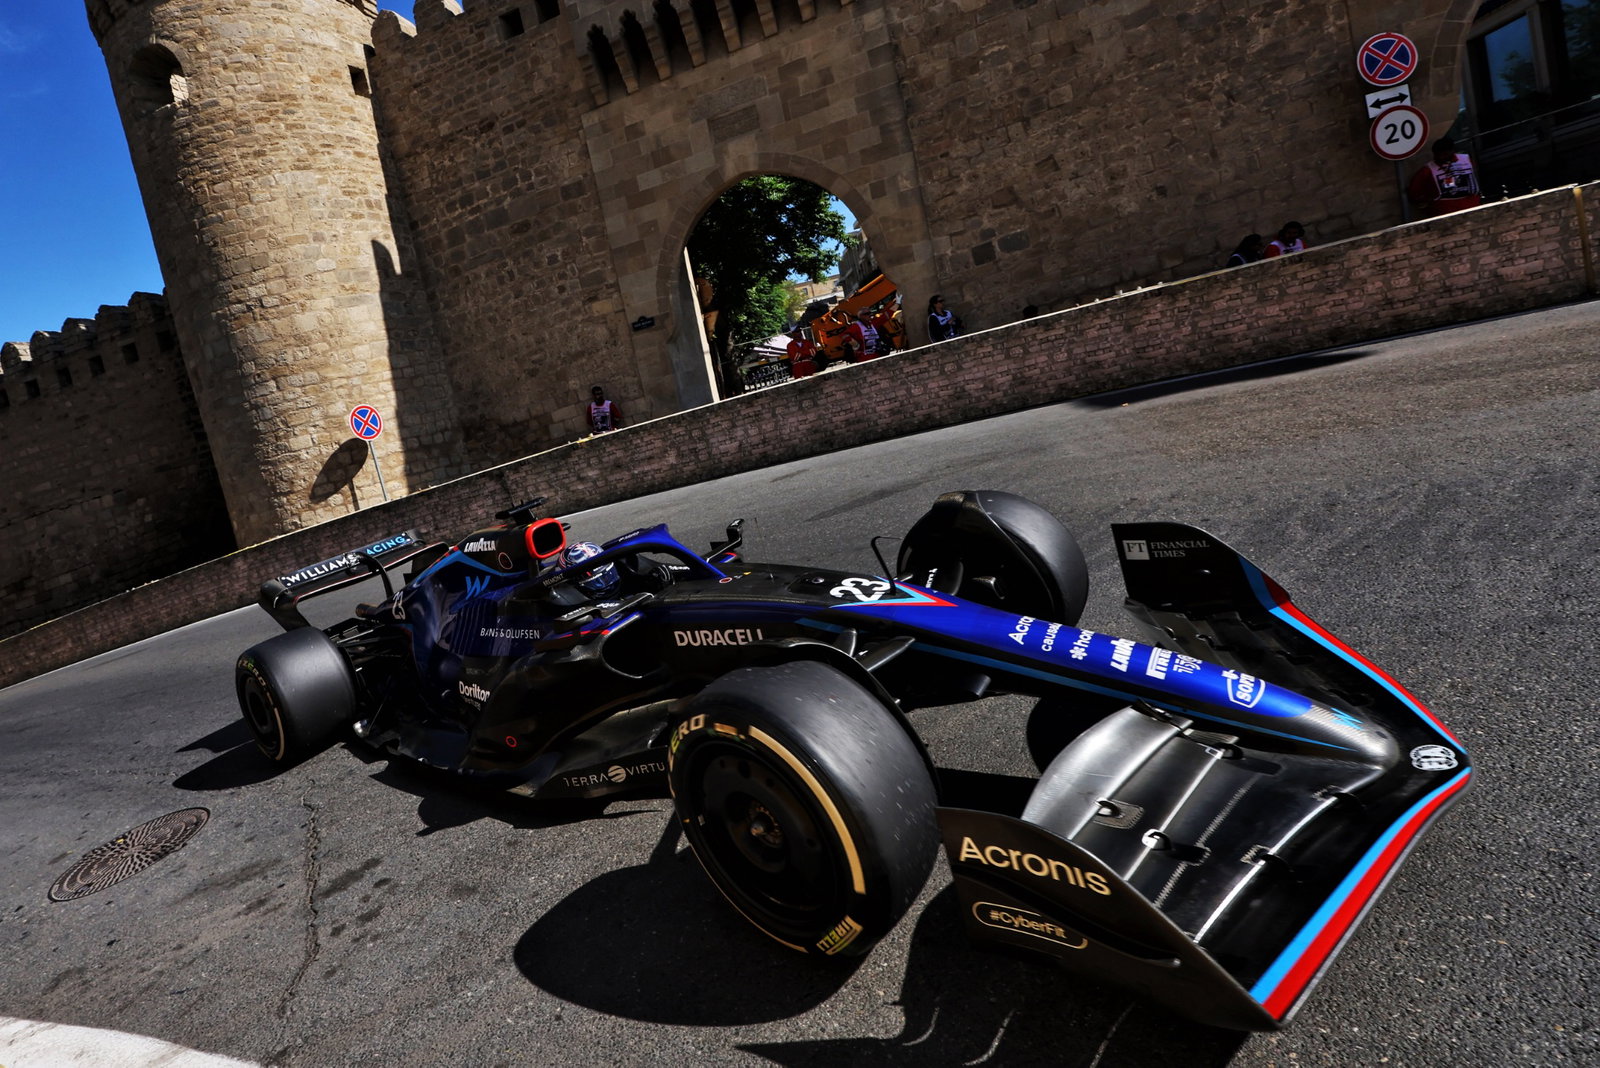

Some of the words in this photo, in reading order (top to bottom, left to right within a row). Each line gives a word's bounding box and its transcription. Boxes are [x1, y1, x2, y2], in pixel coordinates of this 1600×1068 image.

[1384, 119, 1416, 145] 20
[463, 537, 497, 553] LAVAZZA
[1126, 542, 1145, 553] FT
[1150, 539, 1211, 550] FINANCIAL
[1151, 549, 1187, 559] TIMES
[286, 553, 358, 583] WILLIAMS
[366, 536, 406, 556] ACING
[829, 577, 891, 602] 23
[505, 628, 541, 640] OLUFSEN
[563, 772, 609, 788] TERRA
[626, 761, 666, 776] VIRTU
